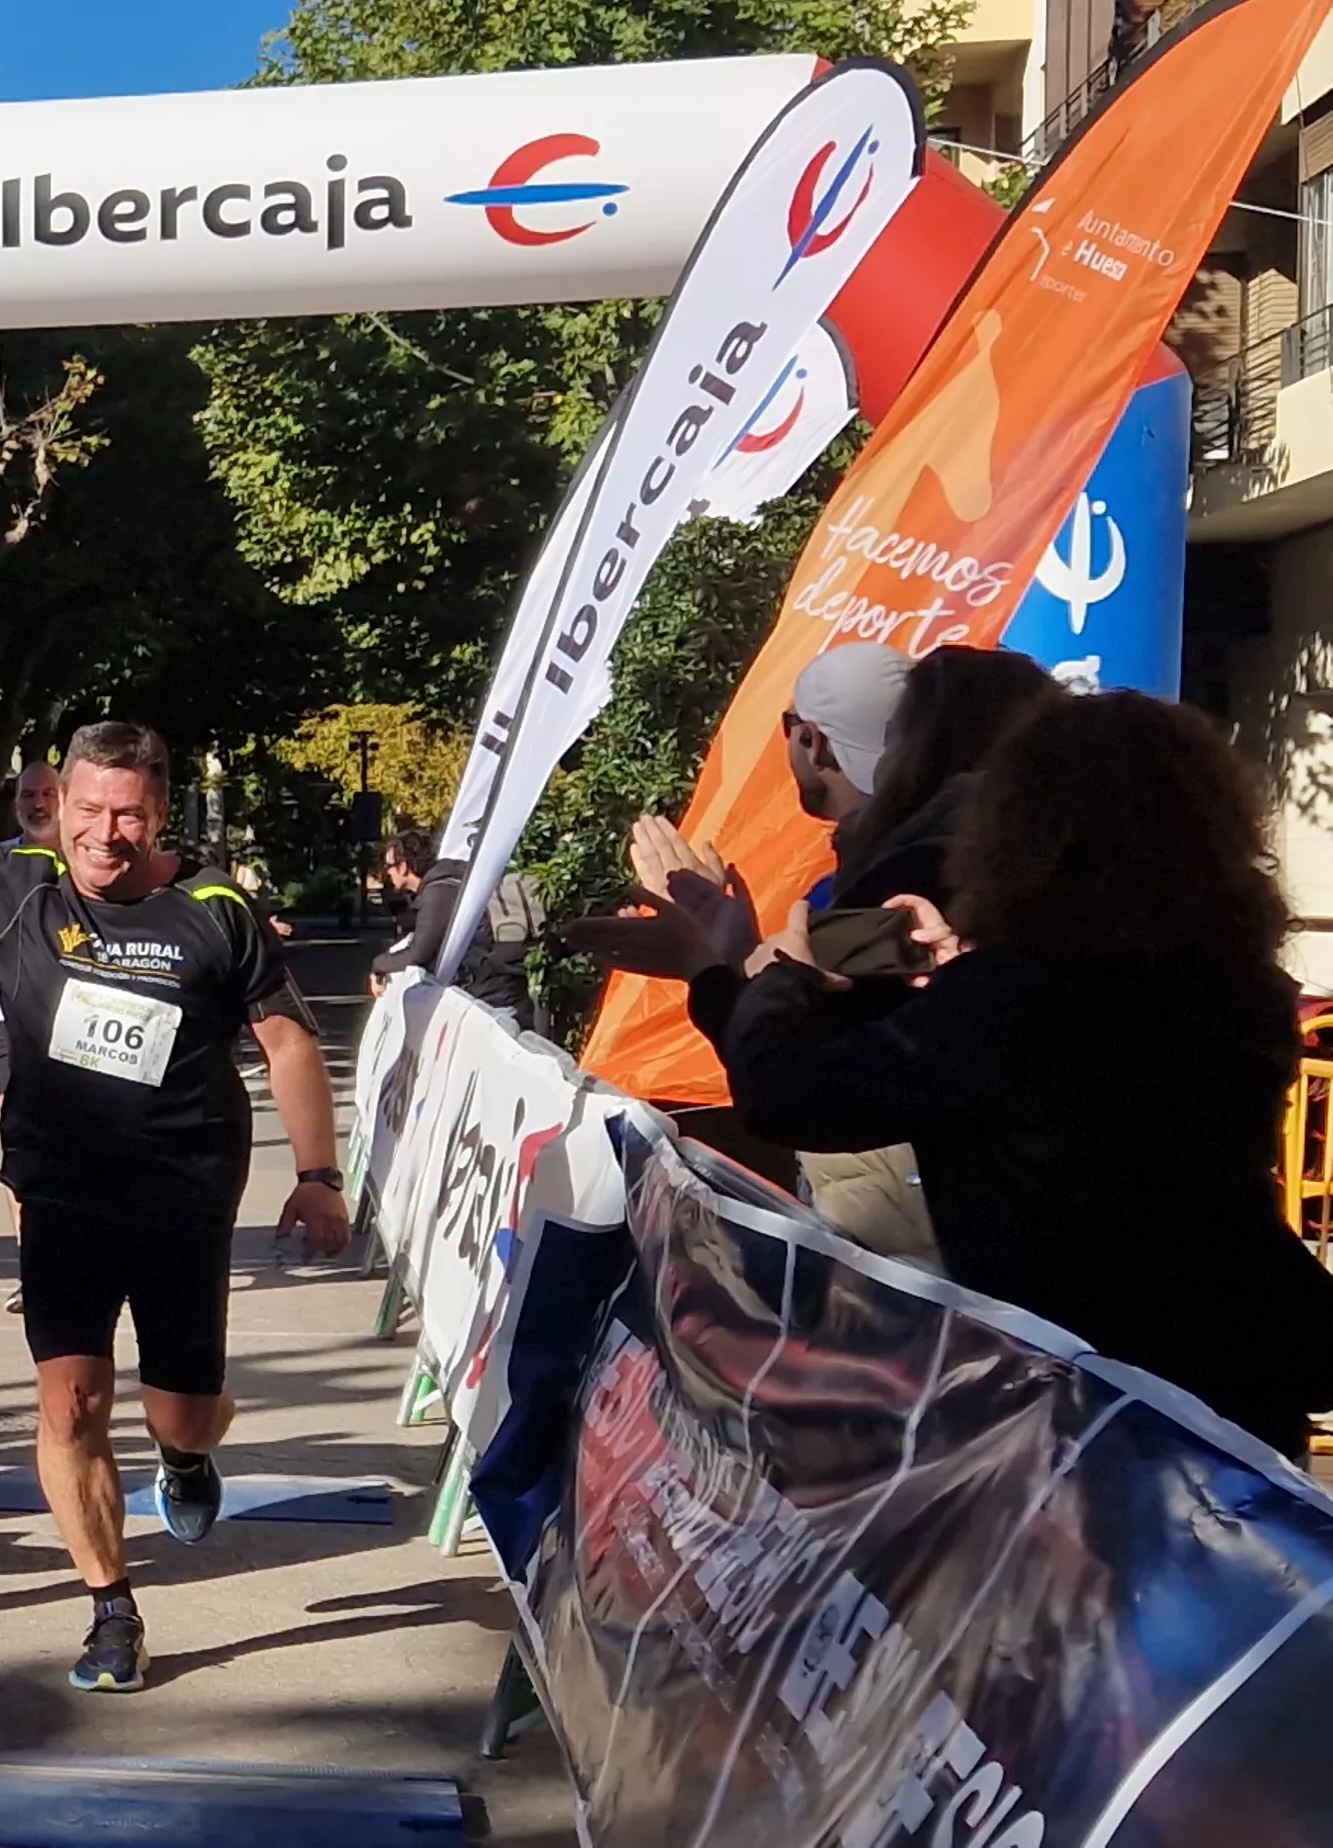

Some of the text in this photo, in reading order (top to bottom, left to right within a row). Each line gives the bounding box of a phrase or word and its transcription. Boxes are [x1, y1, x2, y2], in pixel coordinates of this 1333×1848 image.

[1, 153, 414, 251] Ibercaja
[544, 320, 768, 694] Ibercaja
[827, 495, 1014, 606] Hacemos
[125, 942, 184, 961] RURAL
[74, 1039, 139, 1066] MARCOS
[83, 1013, 146, 1051] 106
